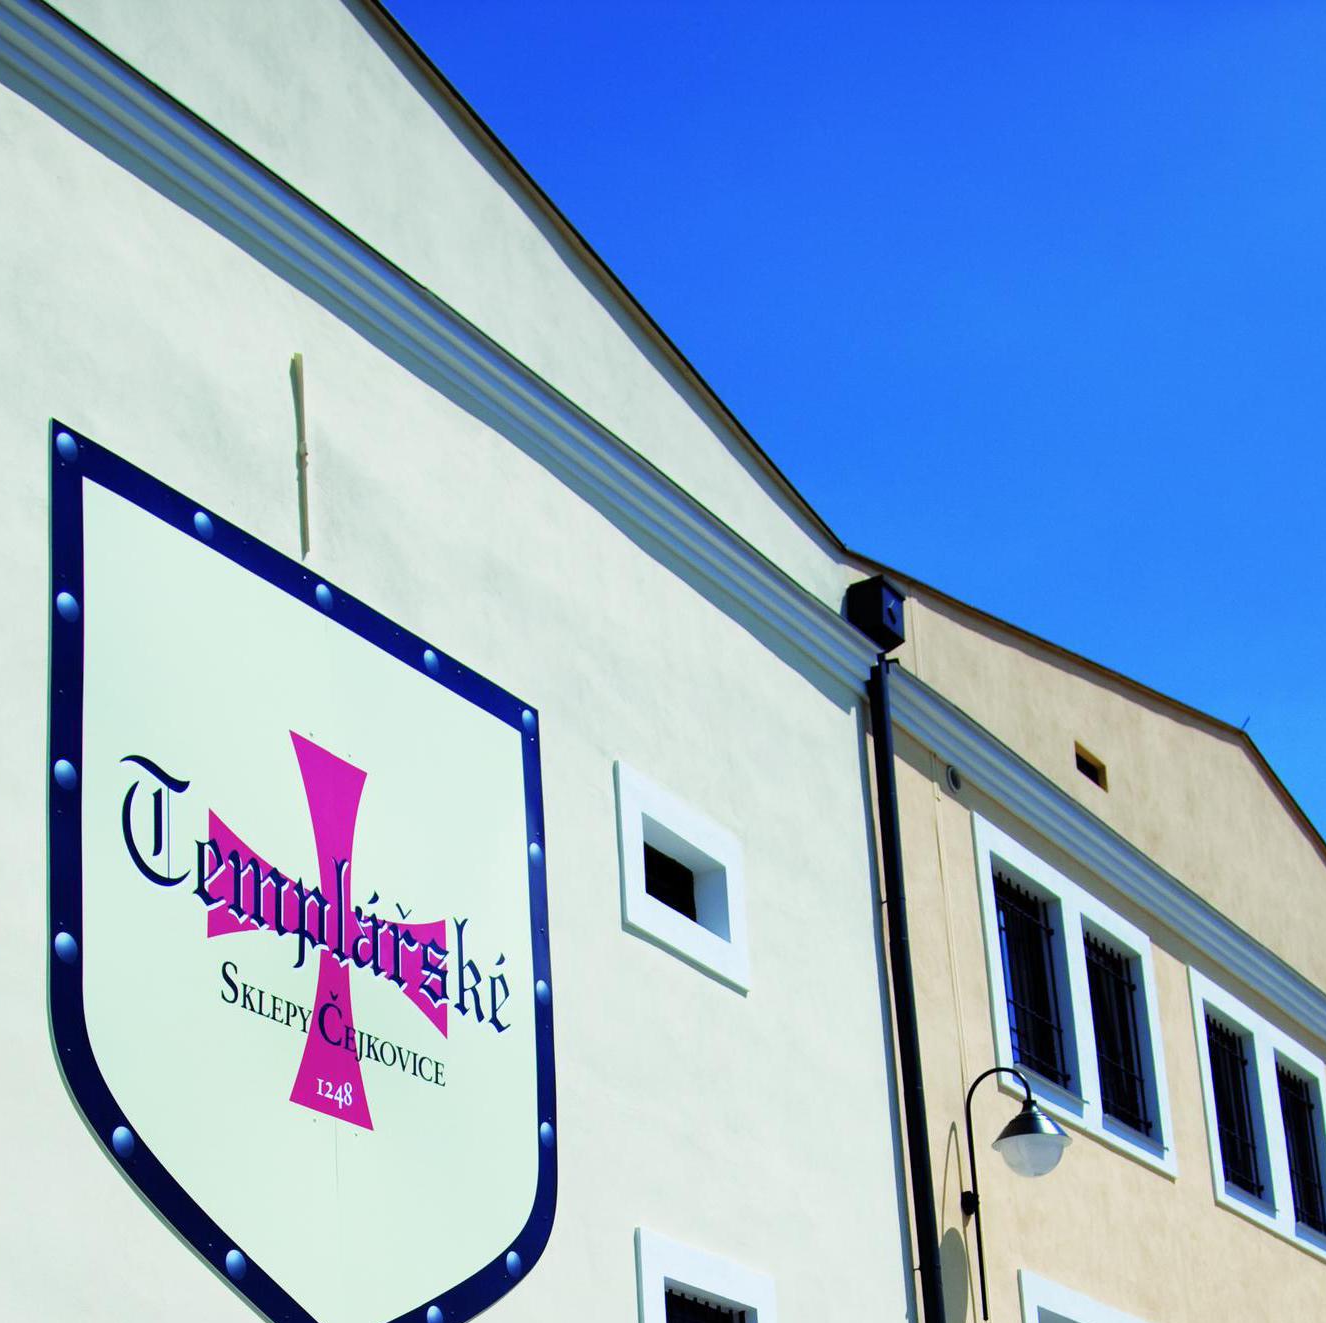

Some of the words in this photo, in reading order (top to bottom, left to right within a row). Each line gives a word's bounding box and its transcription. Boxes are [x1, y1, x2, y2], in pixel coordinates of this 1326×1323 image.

[120, 755, 511, 1033] Templářské
[220, 961, 312, 1034] SKLEPY
[318, 992, 447, 1087] ČEJKOVICE
[316, 1078, 354, 1109] 1248
